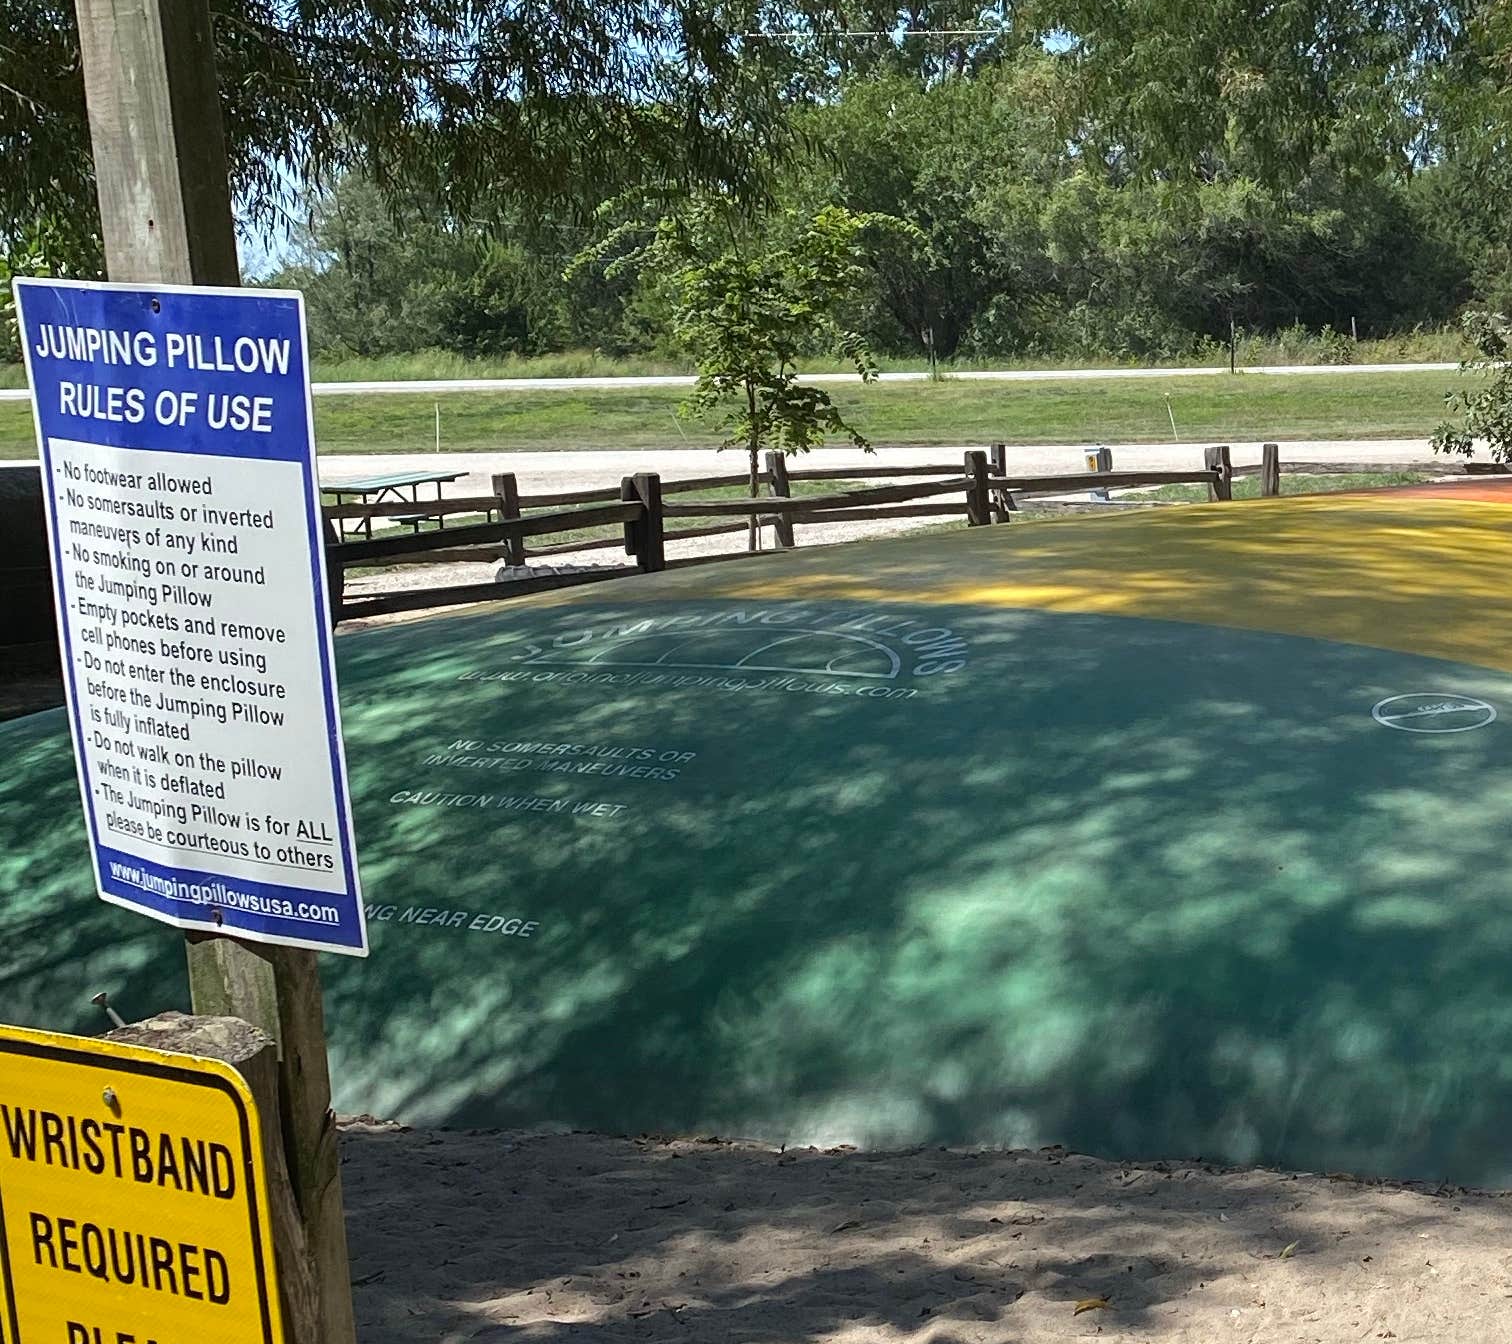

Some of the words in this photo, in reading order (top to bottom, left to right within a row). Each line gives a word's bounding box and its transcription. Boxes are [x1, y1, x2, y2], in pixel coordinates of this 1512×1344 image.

[36, 324, 157, 366] JUMPING
[166, 333, 290, 375] PILLOW
[60, 381, 145, 423] RULES
[155, 391, 198, 427] OF
[207, 395, 273, 433] USE
[63, 460, 81, 480] No
[84, 463, 142, 489] footwear
[147, 471, 212, 495] allowed
[67, 488, 84, 508] No
[88, 495, 175, 521] somersaults
[180, 507, 197, 522] or
[202, 503, 274, 529] inverted
[70, 520, 141, 545] maneuvers
[145, 528, 161, 547] of
[165, 533, 195, 555] any
[200, 532, 238, 554] kind
[72, 542, 90, 563] No
[93, 549, 151, 578] smoking
[156, 560, 176, 576] on
[181, 563, 198, 578] or
[203, 565, 265, 585] around
[75, 570, 95, 591] the
[98, 574, 157, 606] Jumping
[162, 584, 212, 607] Pillow
[78, 596, 118, 626] Empty
[121, 609, 180, 632] pockets
[184, 616, 216, 636] and
[220, 622, 286, 643] remove
[511, 609, 808, 661] JUMPING
[809, 610, 969, 677] PILLOWS
[81, 626, 103, 645] cell
[105, 630, 156, 655] phones
[160, 638, 213, 663] before
[218, 647, 267, 674] using
[83, 650, 102, 671] Do
[104, 659, 126, 677] not
[128, 664, 165, 684] enter
[169, 667, 196, 688] the
[200, 674, 286, 699] enclosure
[86, 677, 127, 703] before
[130, 687, 152, 708] the
[156, 692, 227, 724] Jumping
[232, 701, 285, 727] Pillow
[90, 704, 101, 723] is
[104, 707, 131, 735] fully
[134, 714, 190, 741] inflated
[93, 730, 112, 751] Do
[114, 739, 136, 757] not
[137, 744, 171, 765] walk
[174, 752, 195, 769] on
[199, 752, 226, 773] the
[230, 757, 282, 781] pillow
[421, 754, 533, 771] INVERTED
[536, 759, 681, 781] MANEUVERS
[448, 739, 485, 751] NO
[486, 740, 654, 762] SOMERSAULTS
[658, 751, 697, 764] OR
[97, 759, 130, 782] when
[132, 765, 142, 786] it
[144, 768, 157, 789] is
[160, 773, 226, 800] deflated
[100, 782, 125, 805] The
[127, 790, 187, 825] Jumping
[190, 803, 241, 829] Pillow
[244, 811, 261, 832] is
[264, 815, 290, 836] for
[296, 819, 334, 842] ALL
[389, 790, 495, 808] CAUTION
[497, 796, 569, 813] WHEN
[571, 801, 628, 818] WET
[106, 810, 146, 837] please
[146, 820, 163, 842] be
[166, 830, 250, 857] courteous
[254, 840, 271, 860] to
[276, 845, 334, 869] others
[109, 860, 340, 924] www.jumpingpillowsusa.com
[398, 906, 468, 928] NEAR
[468, 914, 540, 939] EDGE
[0, 1104, 237, 1200] WRISTBAND
[29, 1211, 231, 1306] REQUIRED
